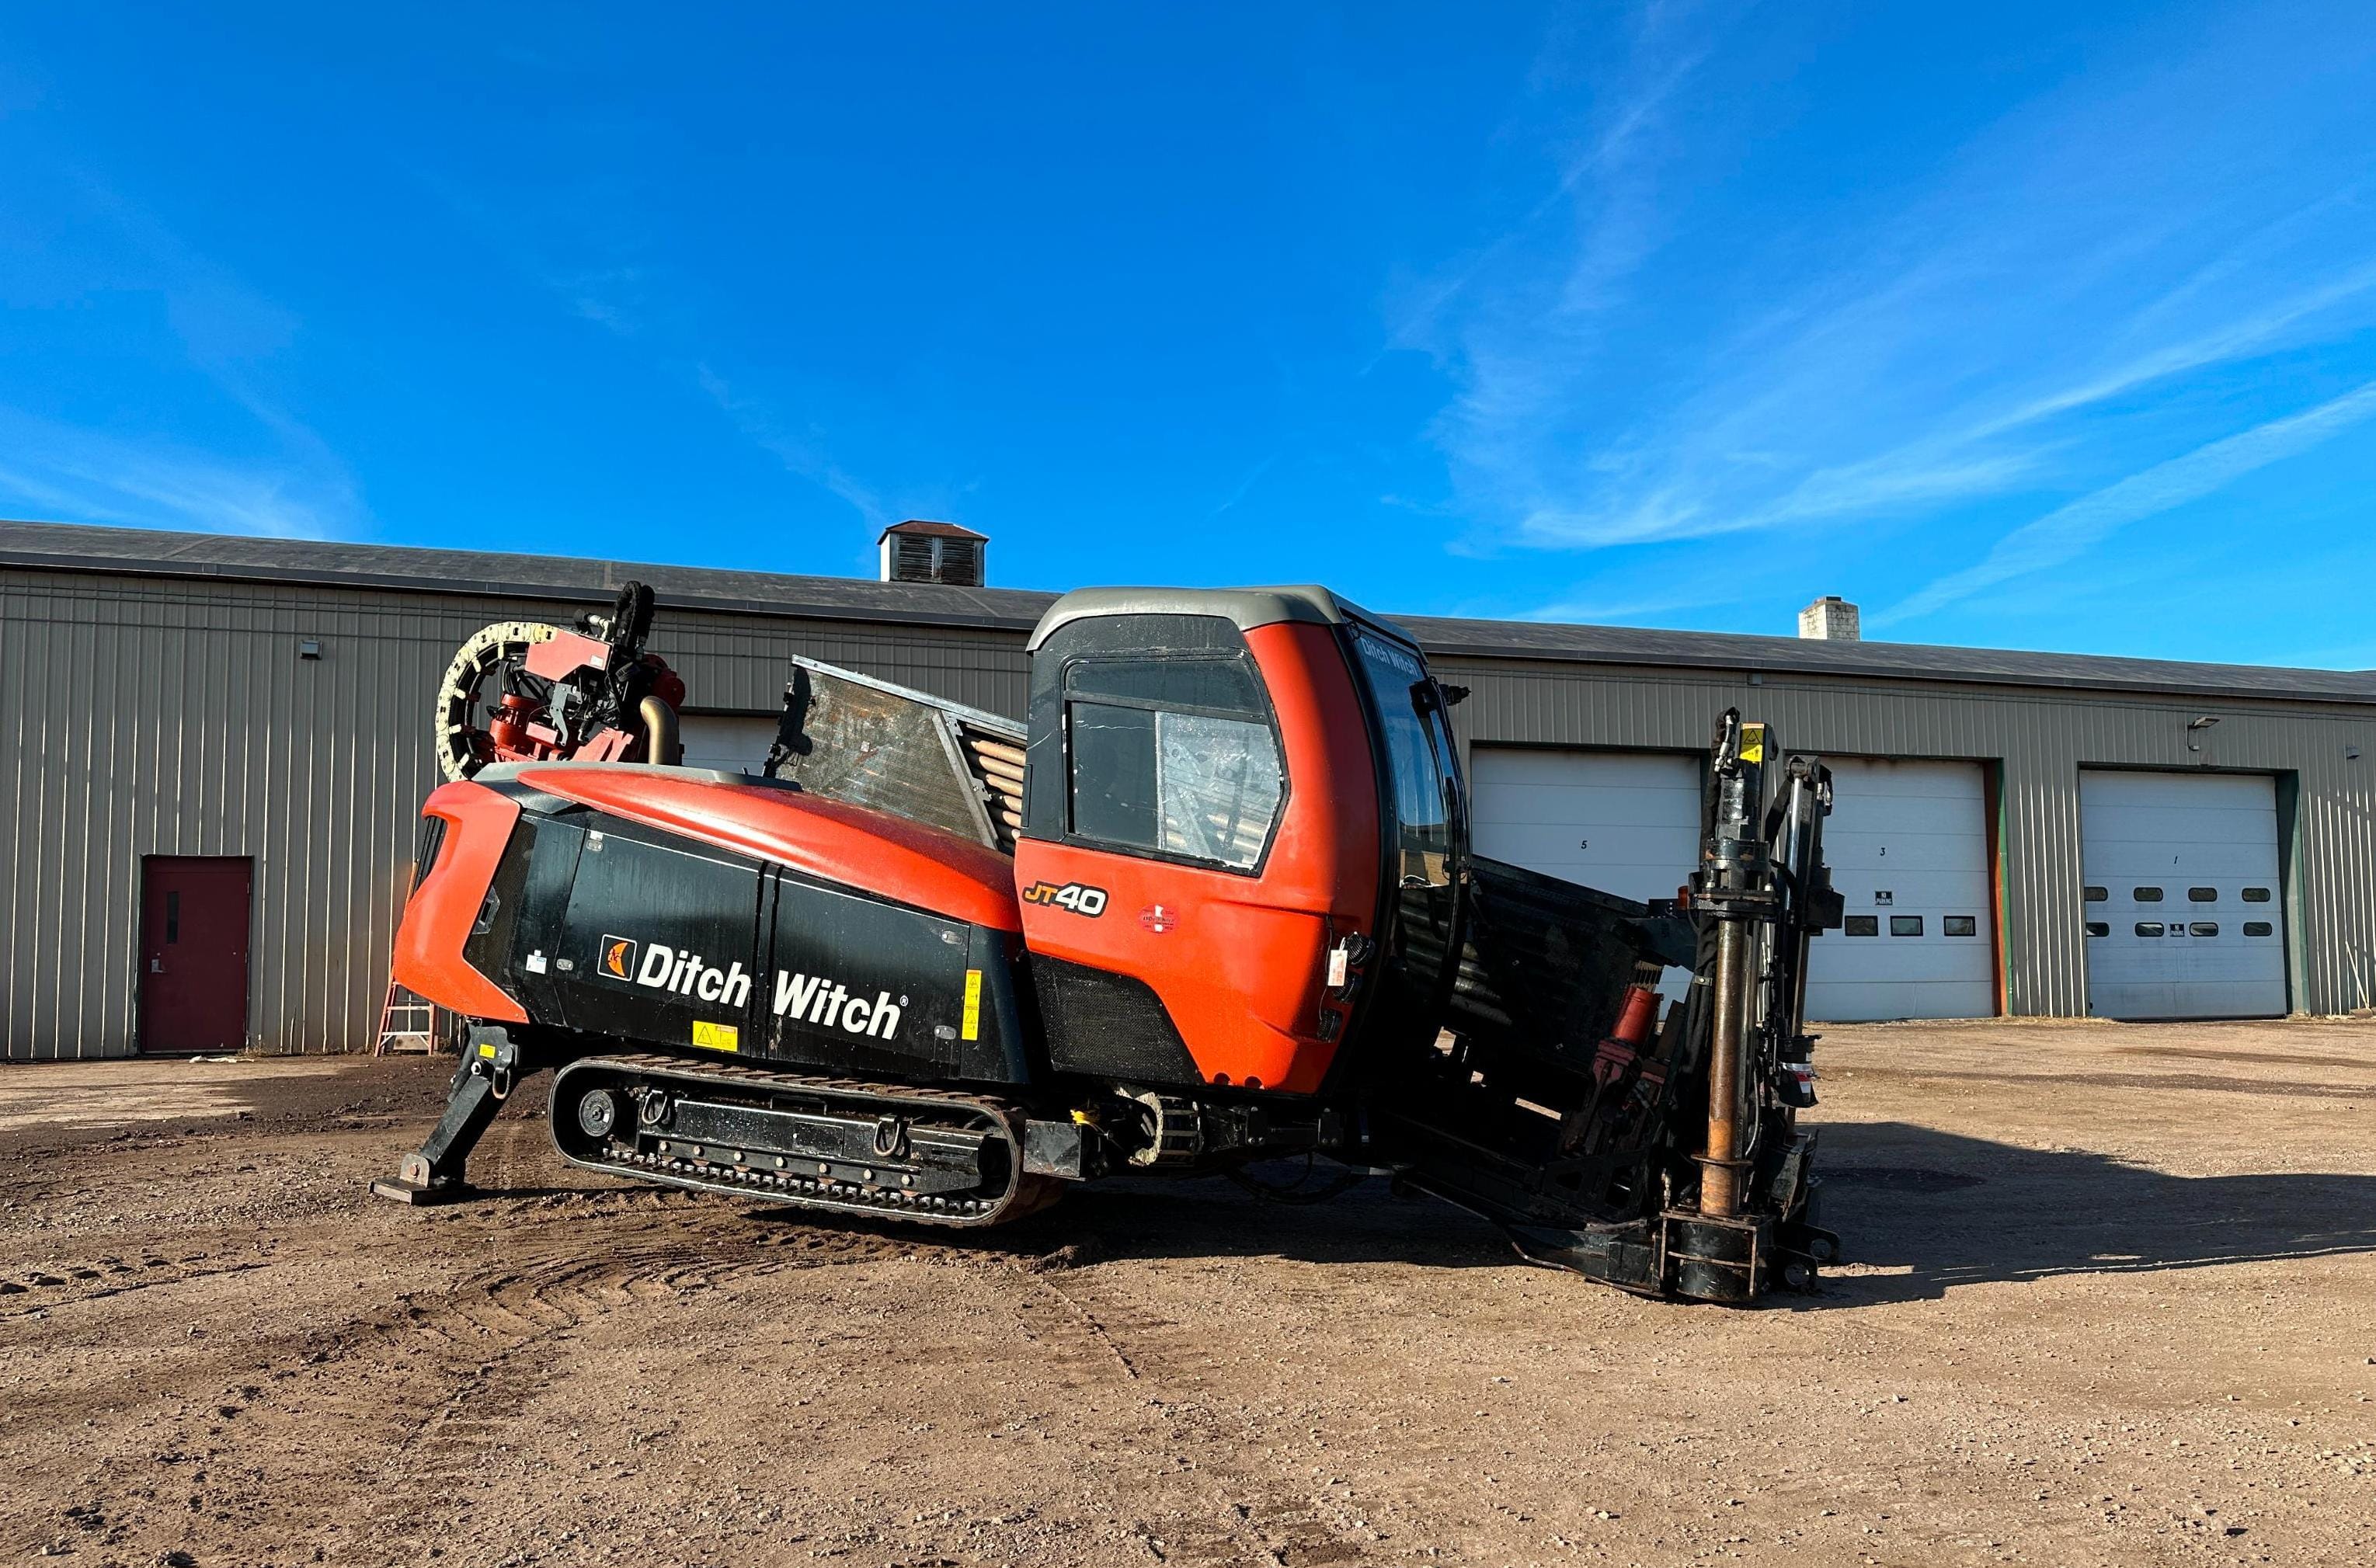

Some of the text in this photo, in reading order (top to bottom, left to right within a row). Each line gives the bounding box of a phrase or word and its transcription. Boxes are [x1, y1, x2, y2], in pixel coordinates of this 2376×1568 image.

[1359, 637, 1418, 677] Ditch Witch
[1581, 840, 1588, 849] 5
[1880, 847, 1885, 856] 3
[1024, 885, 1106, 915] JT40
[636, 943, 752, 1008] Ditch
